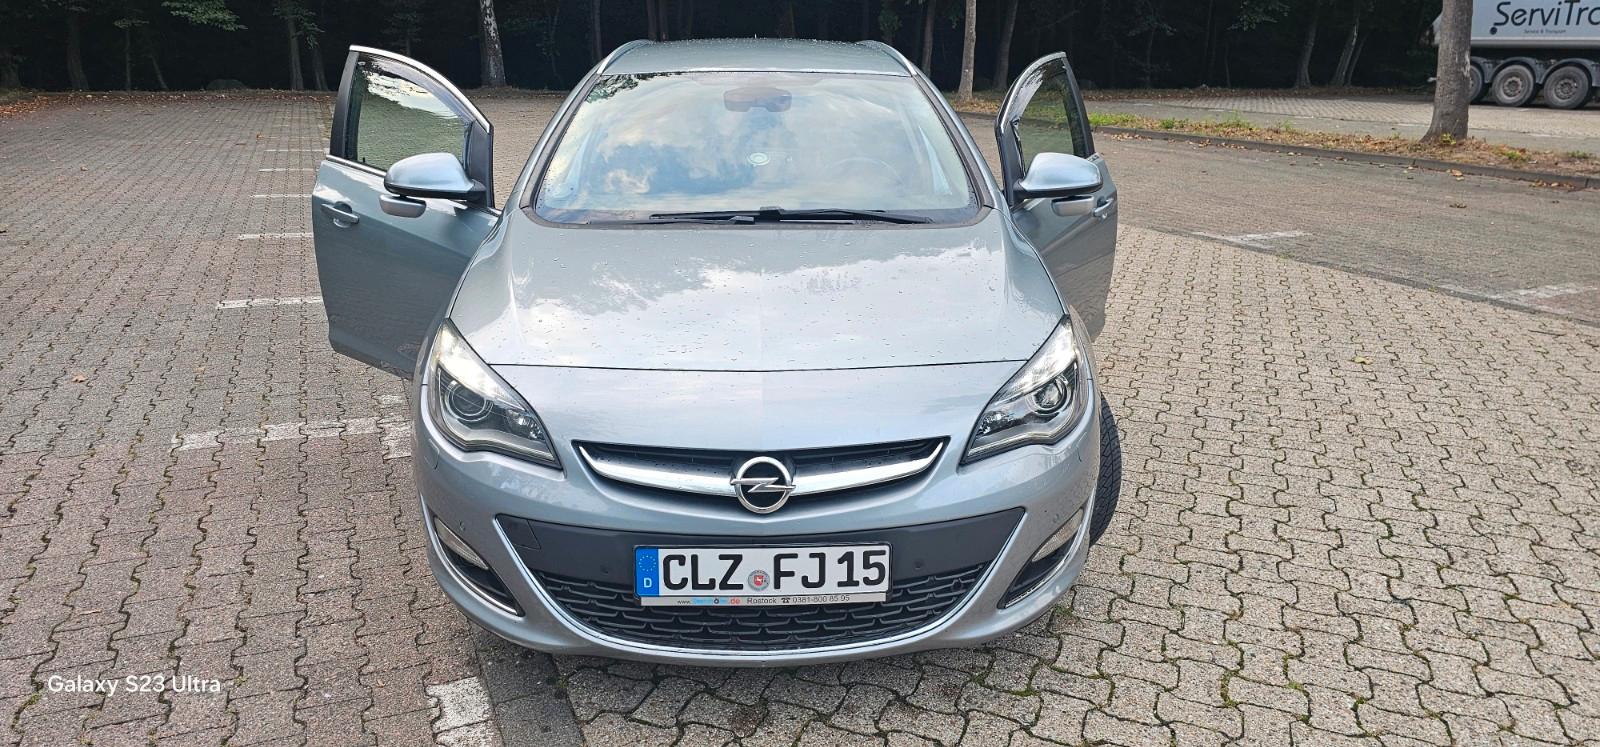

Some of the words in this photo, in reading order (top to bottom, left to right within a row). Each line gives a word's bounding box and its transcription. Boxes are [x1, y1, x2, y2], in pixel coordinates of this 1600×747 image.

[643, 577, 653, 588] D
[662, 553, 744, 591] CLZ
[773, 552, 827, 590] FJ
[836, 550, 887, 588] 15
